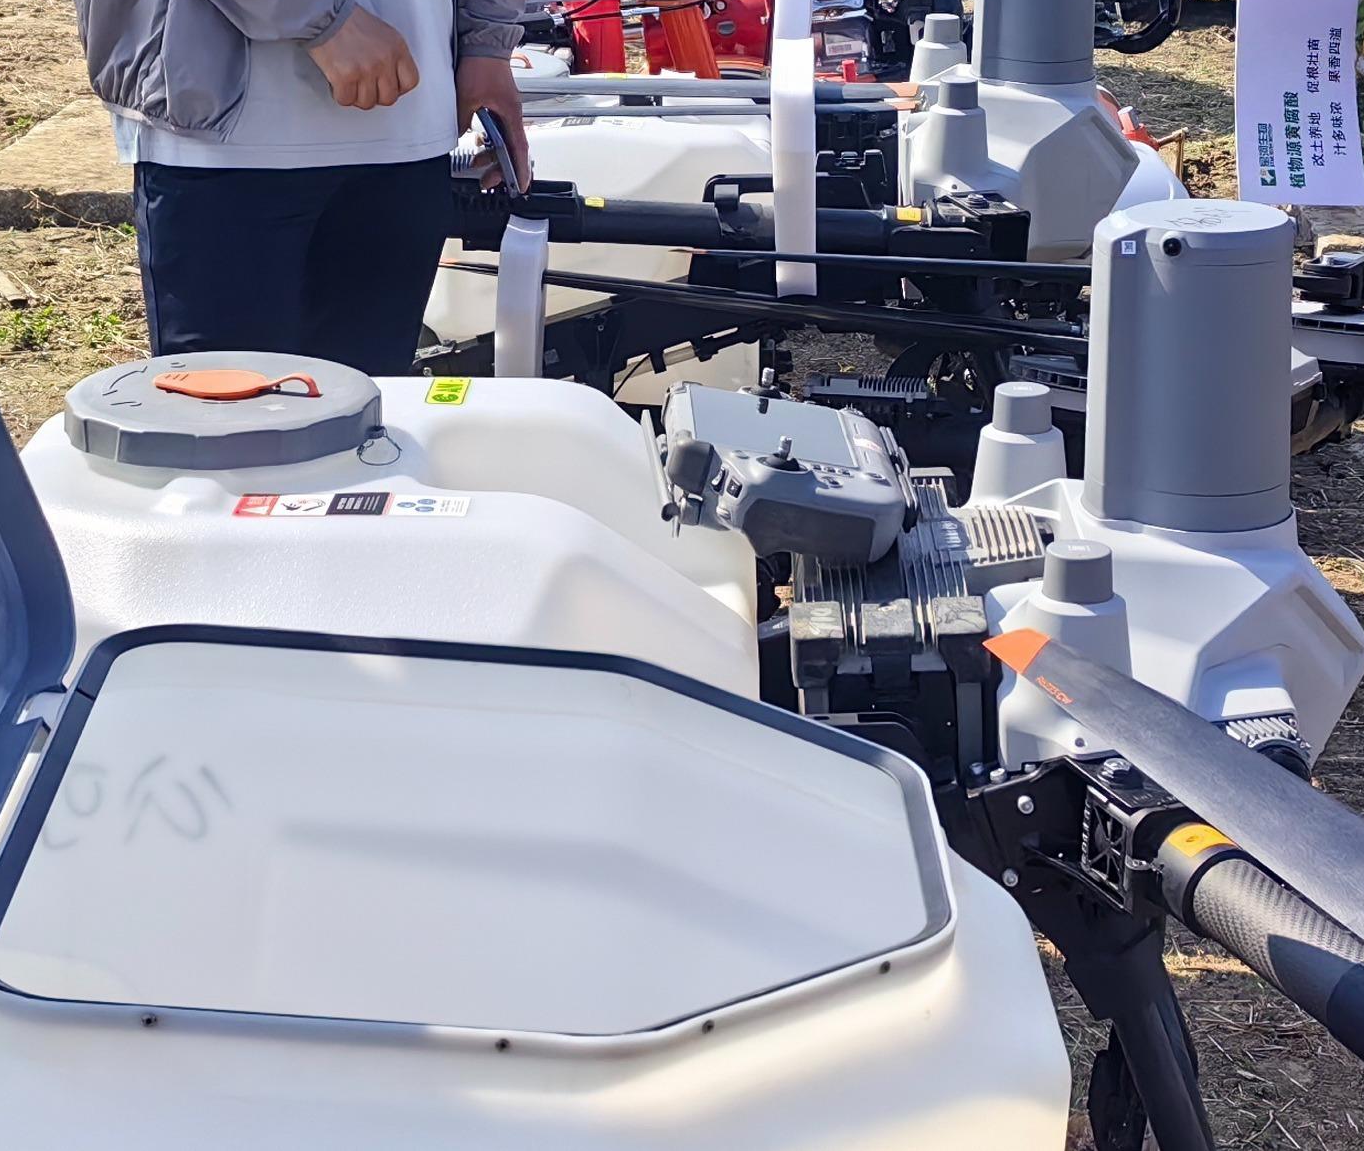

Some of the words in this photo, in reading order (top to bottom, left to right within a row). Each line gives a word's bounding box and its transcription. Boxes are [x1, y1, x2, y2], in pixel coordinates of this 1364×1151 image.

[1328, 27, 1343, 83] 果香四溢
[1283, 91, 1307, 189] 植物源黄腐酸
[1307, 112, 1326, 167] 改土养地
[1329, 101, 1347, 156] 汁多味浓
